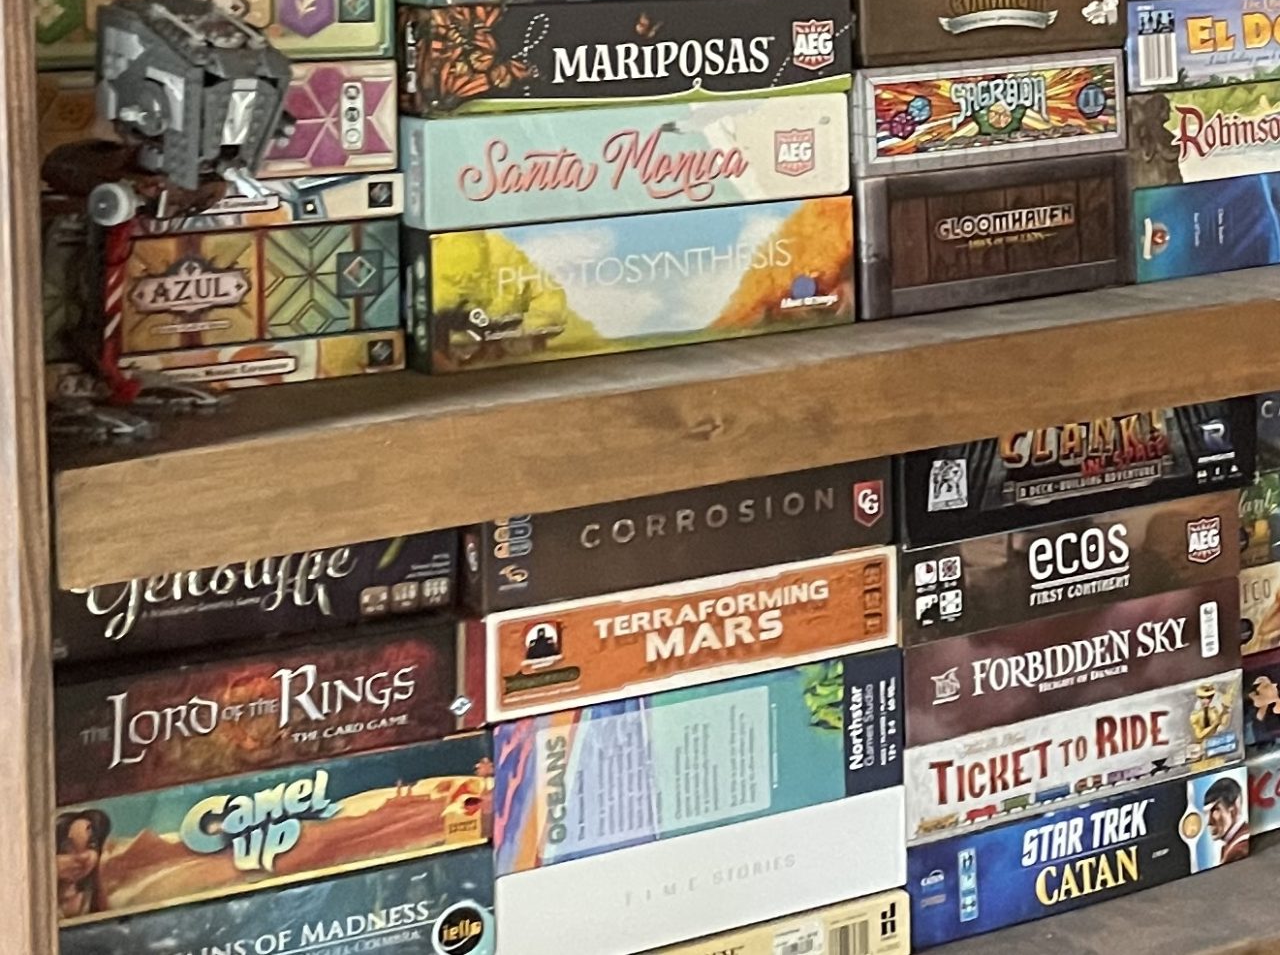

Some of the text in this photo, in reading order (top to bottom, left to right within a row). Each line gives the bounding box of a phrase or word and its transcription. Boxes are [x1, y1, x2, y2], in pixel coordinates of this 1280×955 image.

[551, 36, 771, 85] MARIPOSAS
[794, 32, 833, 56] AEG
[1186, 14, 1236, 54] EL
[456, 126, 749, 203] Santa Monica
[776, 141, 813, 163] AEG
[936, 204, 1076, 241] GLOOMHAVEN
[150, 272, 230, 304] AZUL
[498, 238, 794, 294] PHOTOSYNTHESIS
[580, 486, 835, 550] CORROSION
[1188, 528, 1221, 554] AEG
[593, 579, 831, 640] TERRAFORMING
[1029, 573, 1131, 607] FIRST CONTINENT
[1243, 578, 1271, 605] ICO
[645, 610, 785, 663] MARS
[970, 616, 1190, 696] FORBIDDEN SKY
[1090, 664, 1129, 682] DANGER
[106, 691, 219, 771] LORD
[221, 704, 245, 724] OF
[248, 698, 280, 718] THE
[270, 662, 419, 729] RINGS
[322, 721, 364, 741] CARD
[366, 713, 410, 733] GAME
[849, 685, 864, 771] Northstar
[864, 683, 875, 767] Games Studio
[929, 710, 1171, 806] TICKET TO RIDE
[179, 768, 336, 855] Camel
[548, 734, 567, 844] OCEANS
[1021, 801, 1150, 868] STAR TREK
[625, 853, 799, 909] TIME STORIES
[1034, 845, 1141, 908] CATAN
[254, 929, 292, 955] OF
[299, 899, 430, 947] MADNESS
